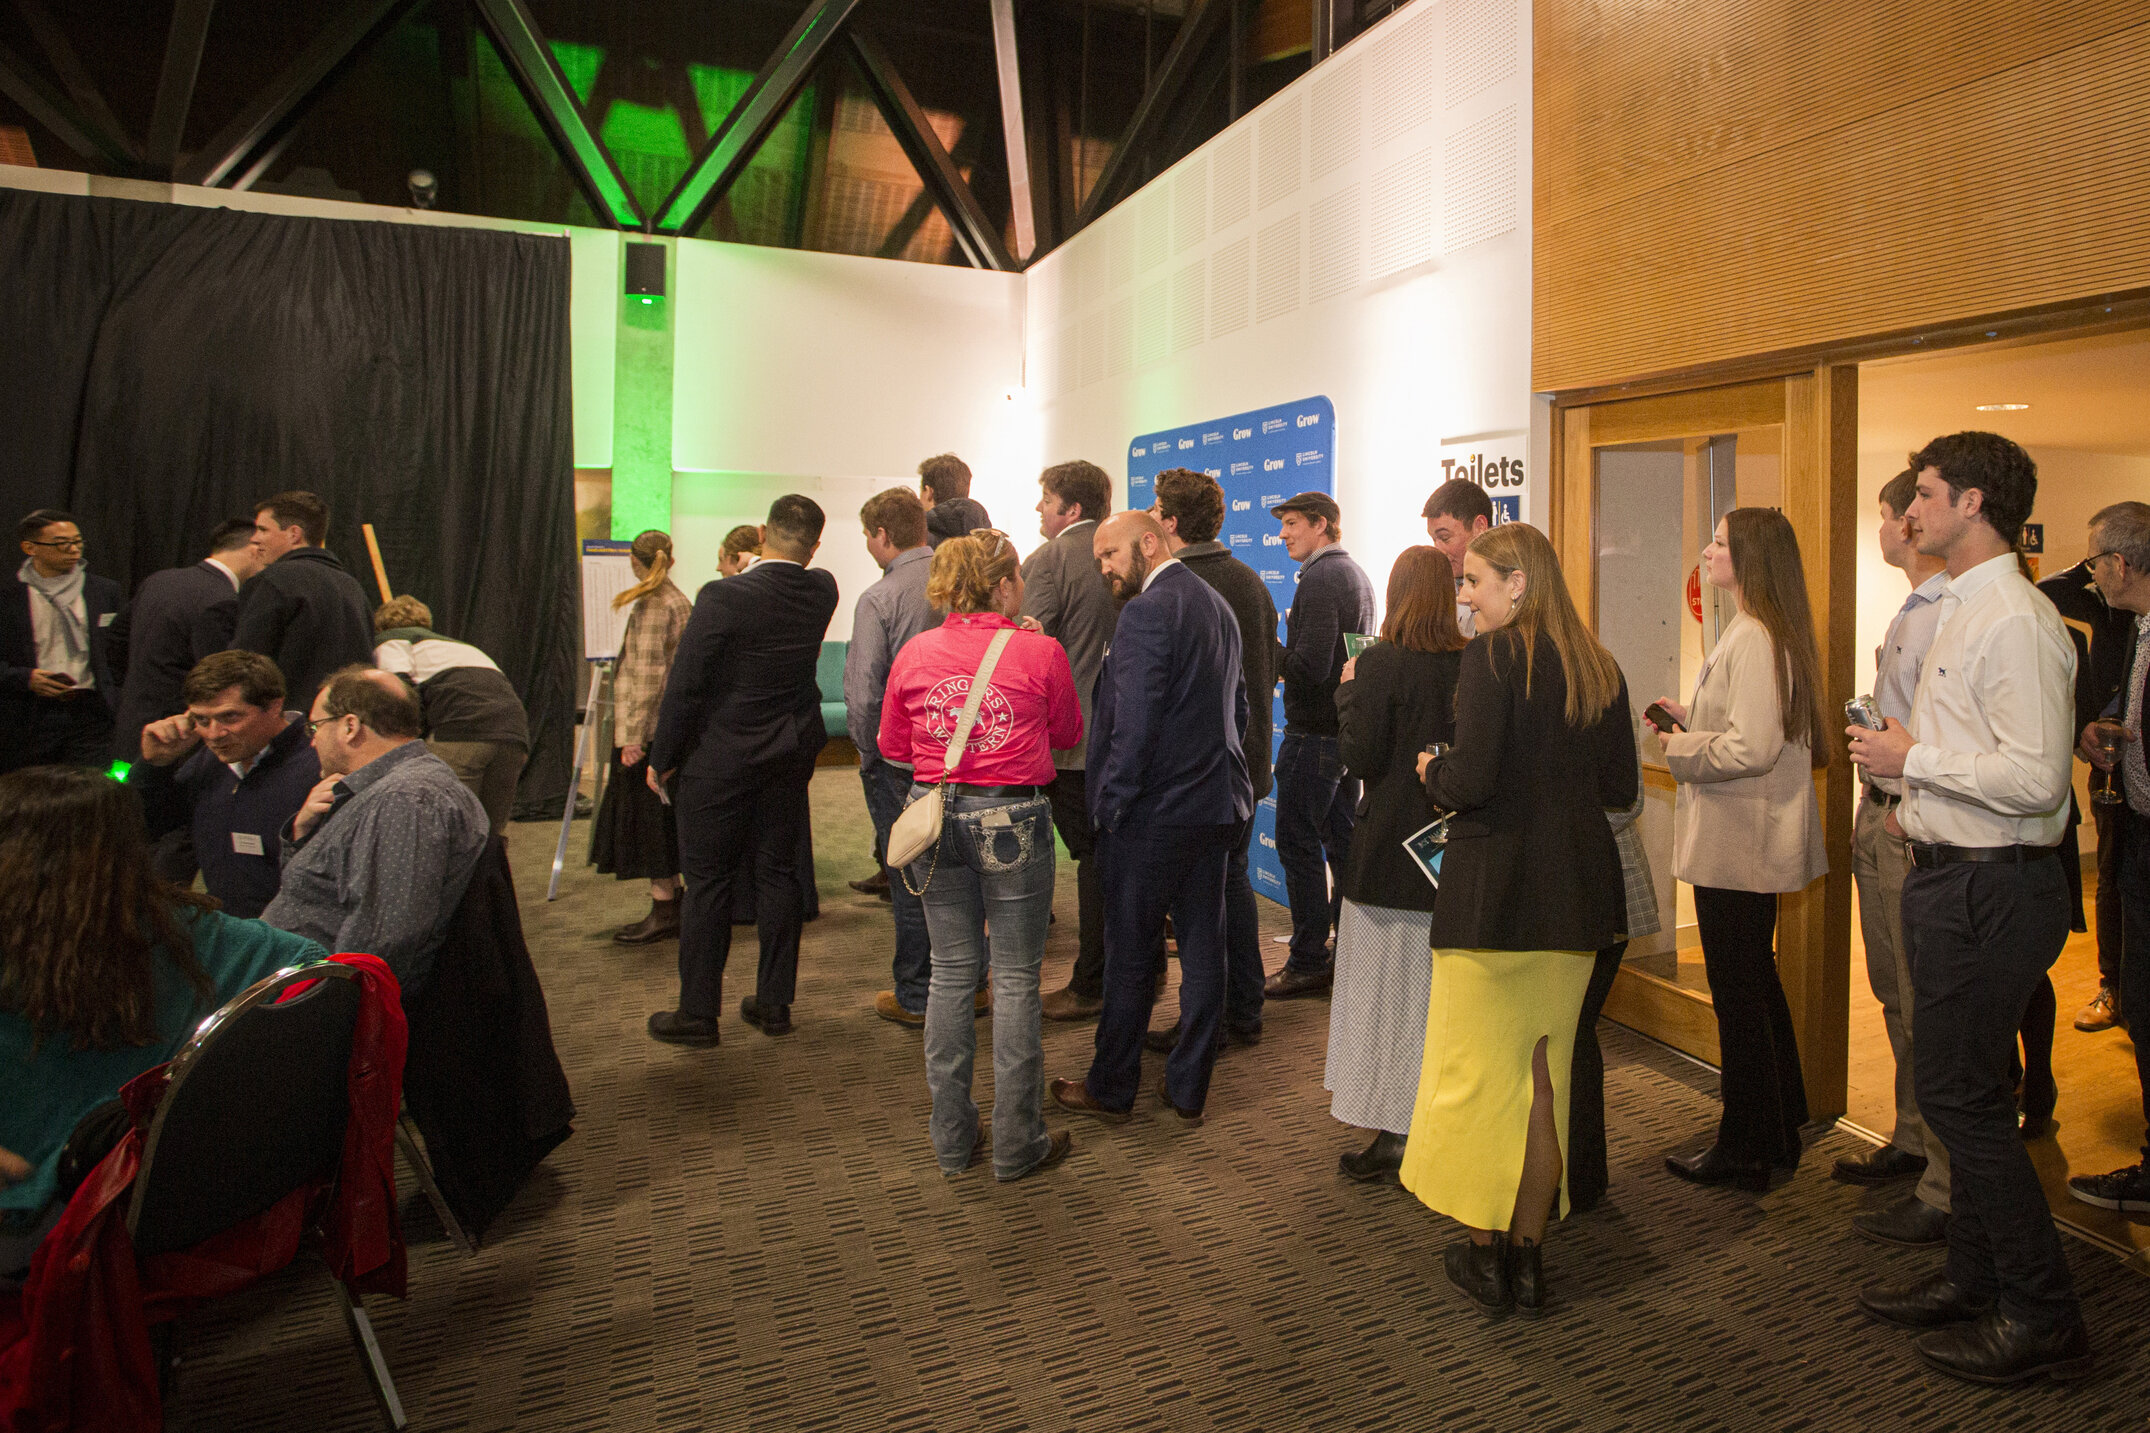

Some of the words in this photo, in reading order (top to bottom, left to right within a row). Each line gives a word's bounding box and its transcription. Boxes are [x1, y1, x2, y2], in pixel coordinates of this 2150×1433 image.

[1296, 414, 1320, 428] Grow
[1233, 428, 1252, 440] Grow
[1264, 459, 1284, 471] Grow
[1441, 454, 1524, 488] Toilets
[1232, 499, 1251, 511] Grow
[928, 679, 1004, 708] RINGRS
[933, 725, 1006, 753] WTERN
